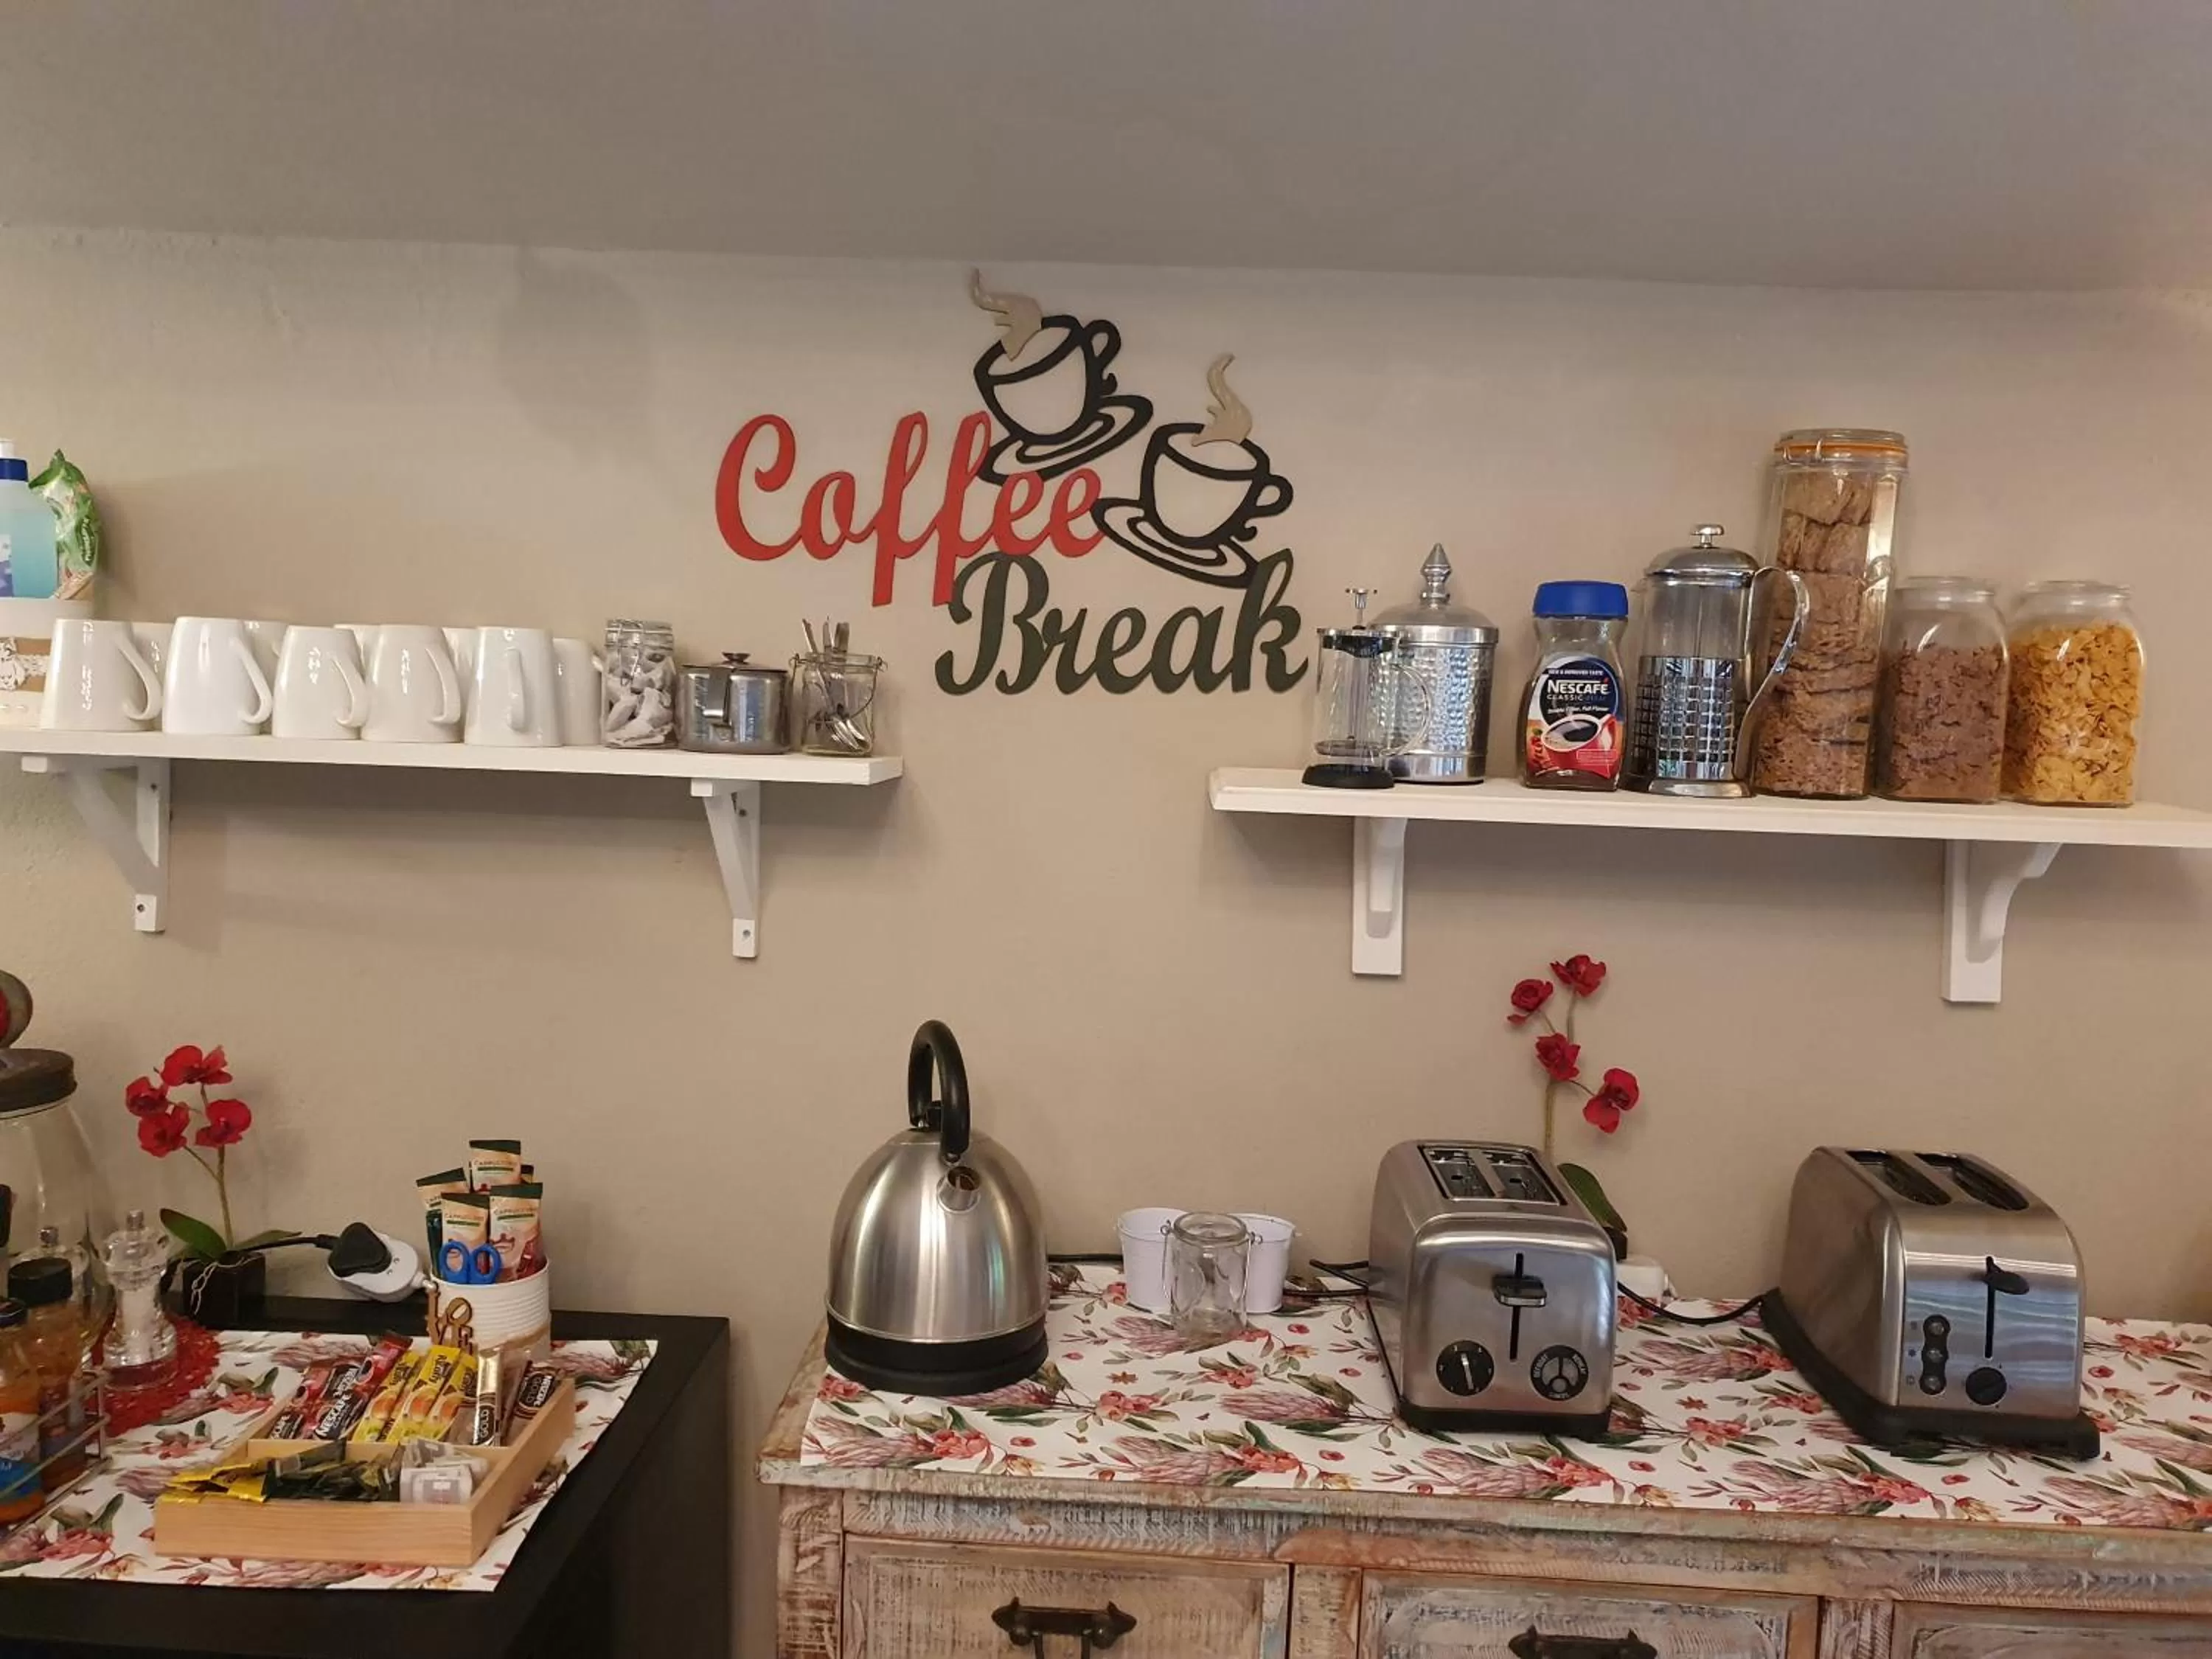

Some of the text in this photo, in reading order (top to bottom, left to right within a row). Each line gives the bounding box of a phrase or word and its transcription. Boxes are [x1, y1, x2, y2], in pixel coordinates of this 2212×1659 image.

[714, 411, 1106, 608] Coffee
[935, 548, 1309, 695] Break
[1546, 693, 1584, 701] CLASSIC
[479, 1408, 490, 1439] GOLD
